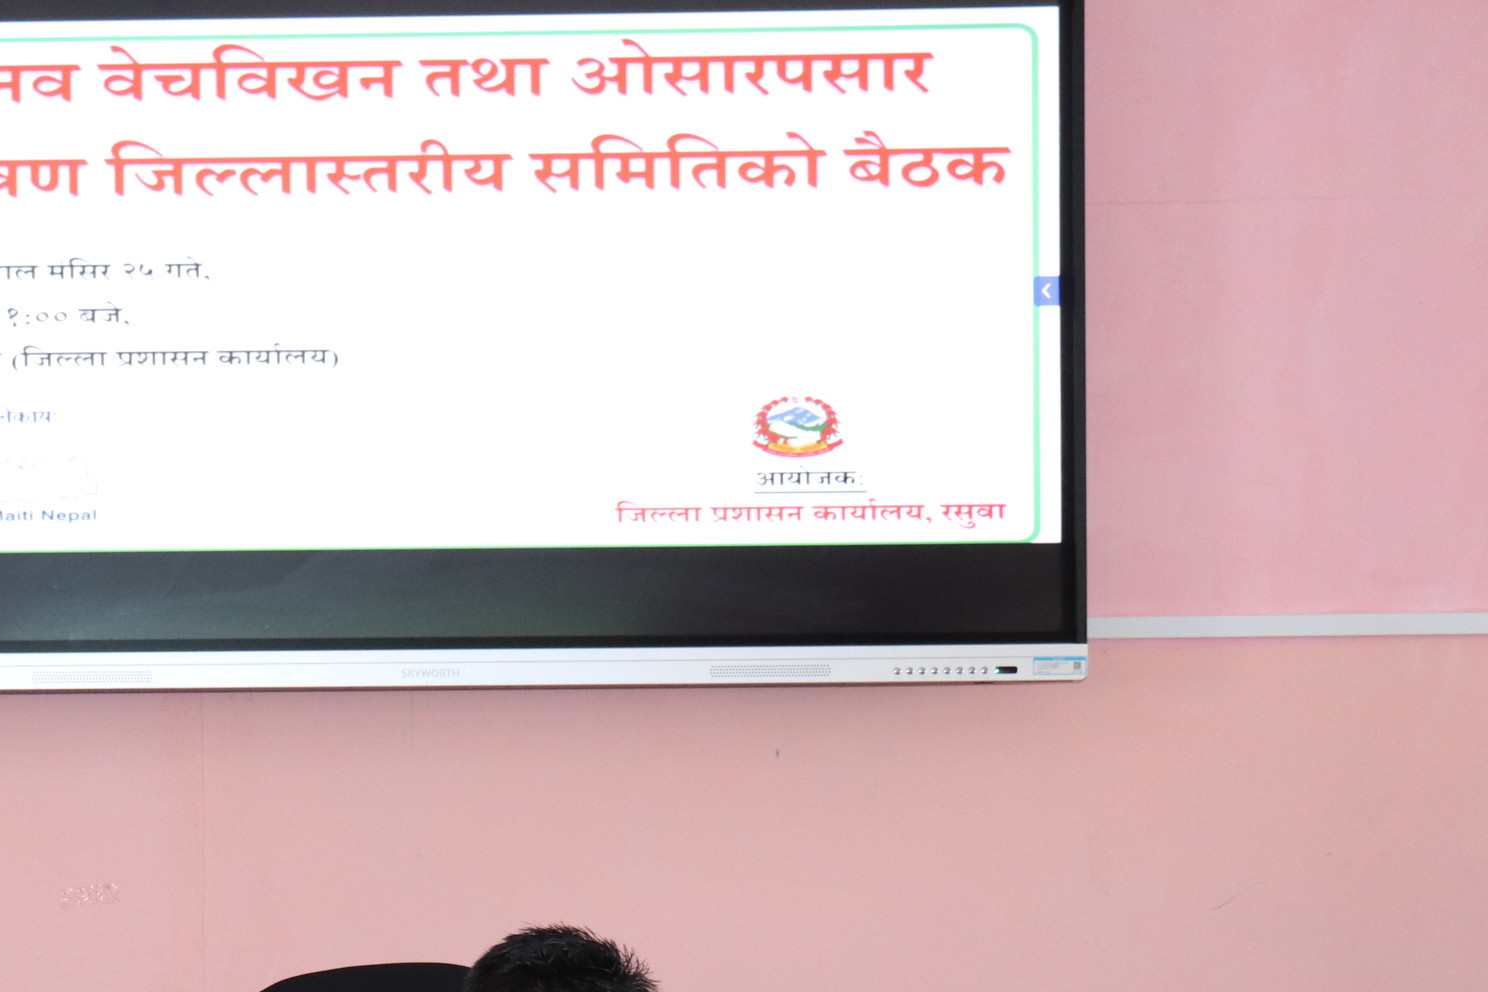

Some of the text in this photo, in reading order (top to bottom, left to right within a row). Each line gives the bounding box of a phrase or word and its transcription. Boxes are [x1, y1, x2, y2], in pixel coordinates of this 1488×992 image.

[97, 44, 404, 101] वेचविखन
[419, 58, 551, 97] तथा
[572, 39, 935, 96] ओसारपसार
[105, 139, 514, 196] जिल्लास्तरीय
[529, 132, 828, 193] समितिको
[843, 131, 1012, 187] बैठक
[46, 257, 112, 280] मंसिर
[123, 263, 154, 279] २५
[11, 345, 108, 371] (जिल्ला
[115, 350, 210, 368] प्रशासन
[216, 343, 339, 368] कार्यालय)
[41, 509, 97, 524] Nepal
[615, 498, 1008, 529] जिल्ला प्रशासन कार्यालय, रसुवा
[401, 668, 460, 678] SKYWORTH
